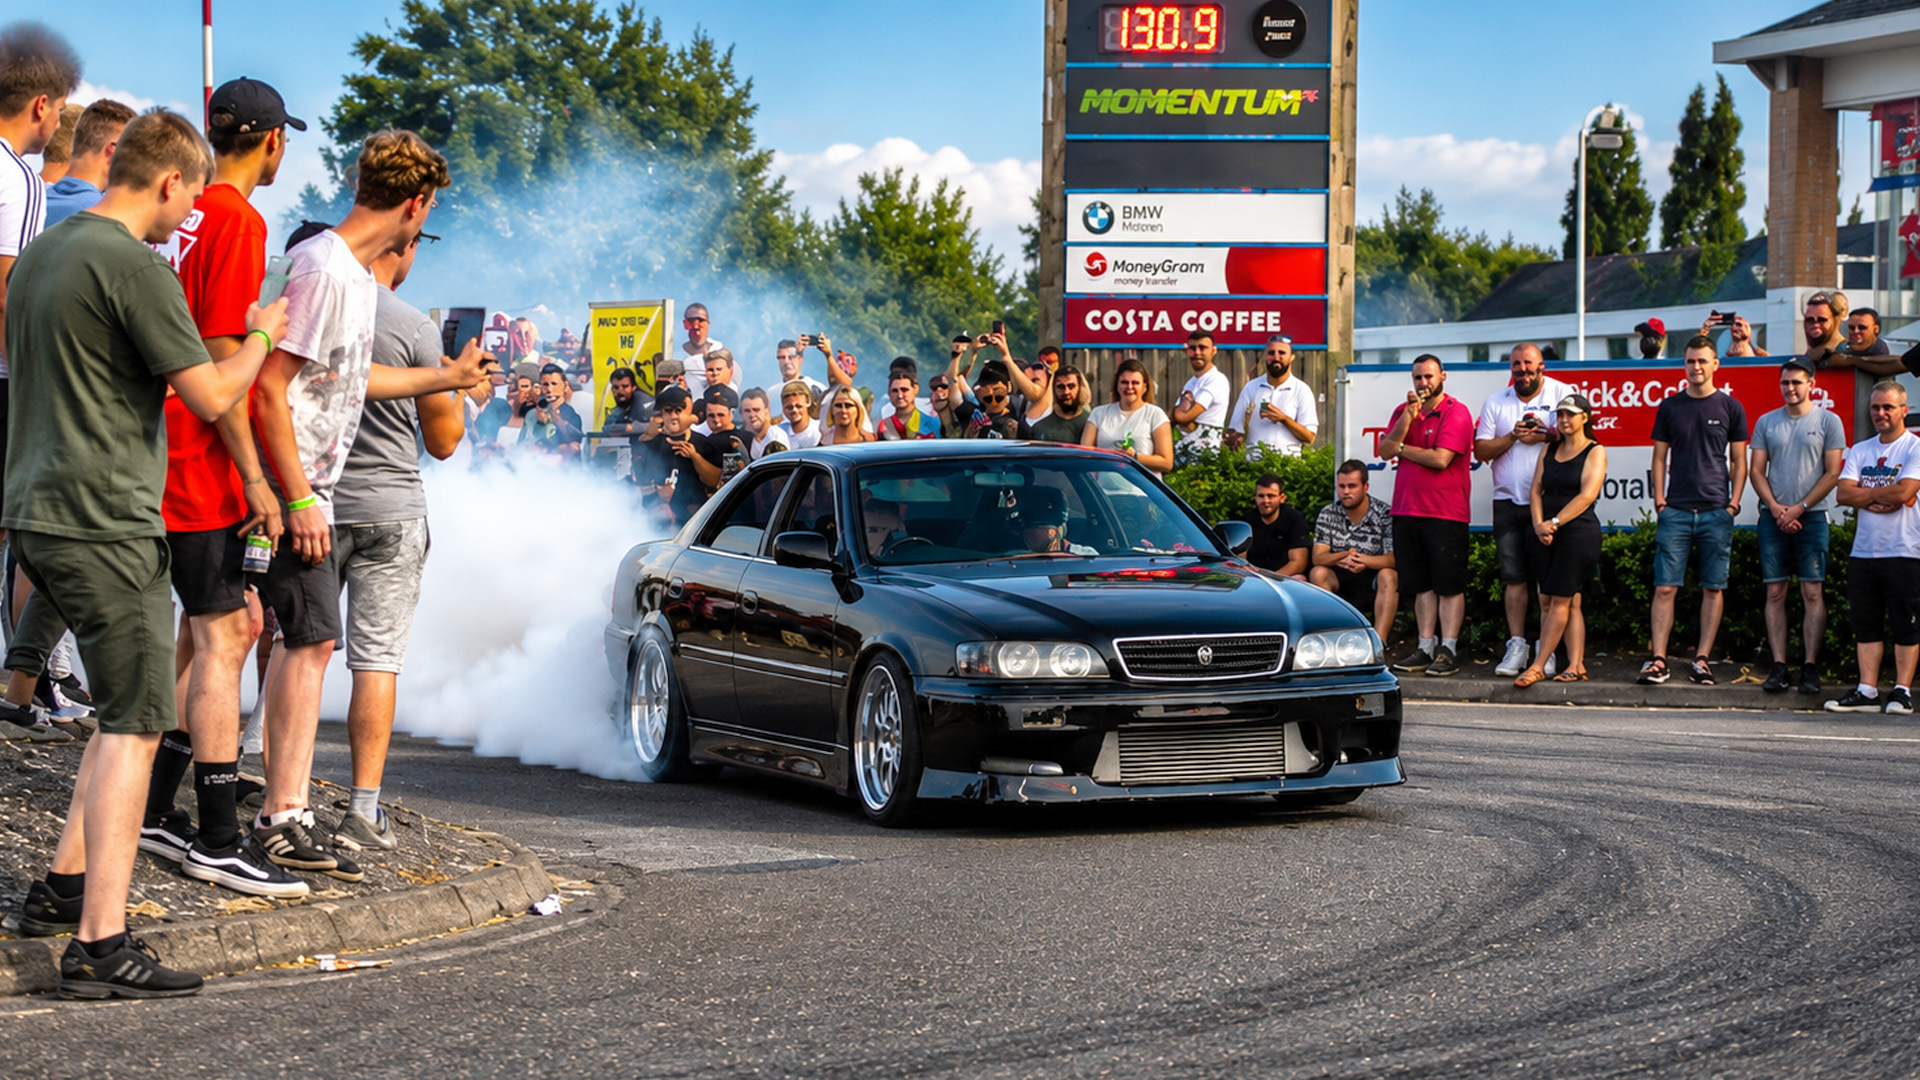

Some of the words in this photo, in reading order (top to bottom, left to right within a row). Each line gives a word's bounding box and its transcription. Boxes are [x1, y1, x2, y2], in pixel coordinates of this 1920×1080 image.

[1120, 6, 1218, 51] 130.9
[1079, 87, 1302, 116] MOMENTUM
[1122, 205, 1164, 219] BMW
[1112, 259, 1205, 276] MoneyGram
[1085, 309, 1174, 335] COSTA
[1180, 309, 1282, 332] COFFEE
